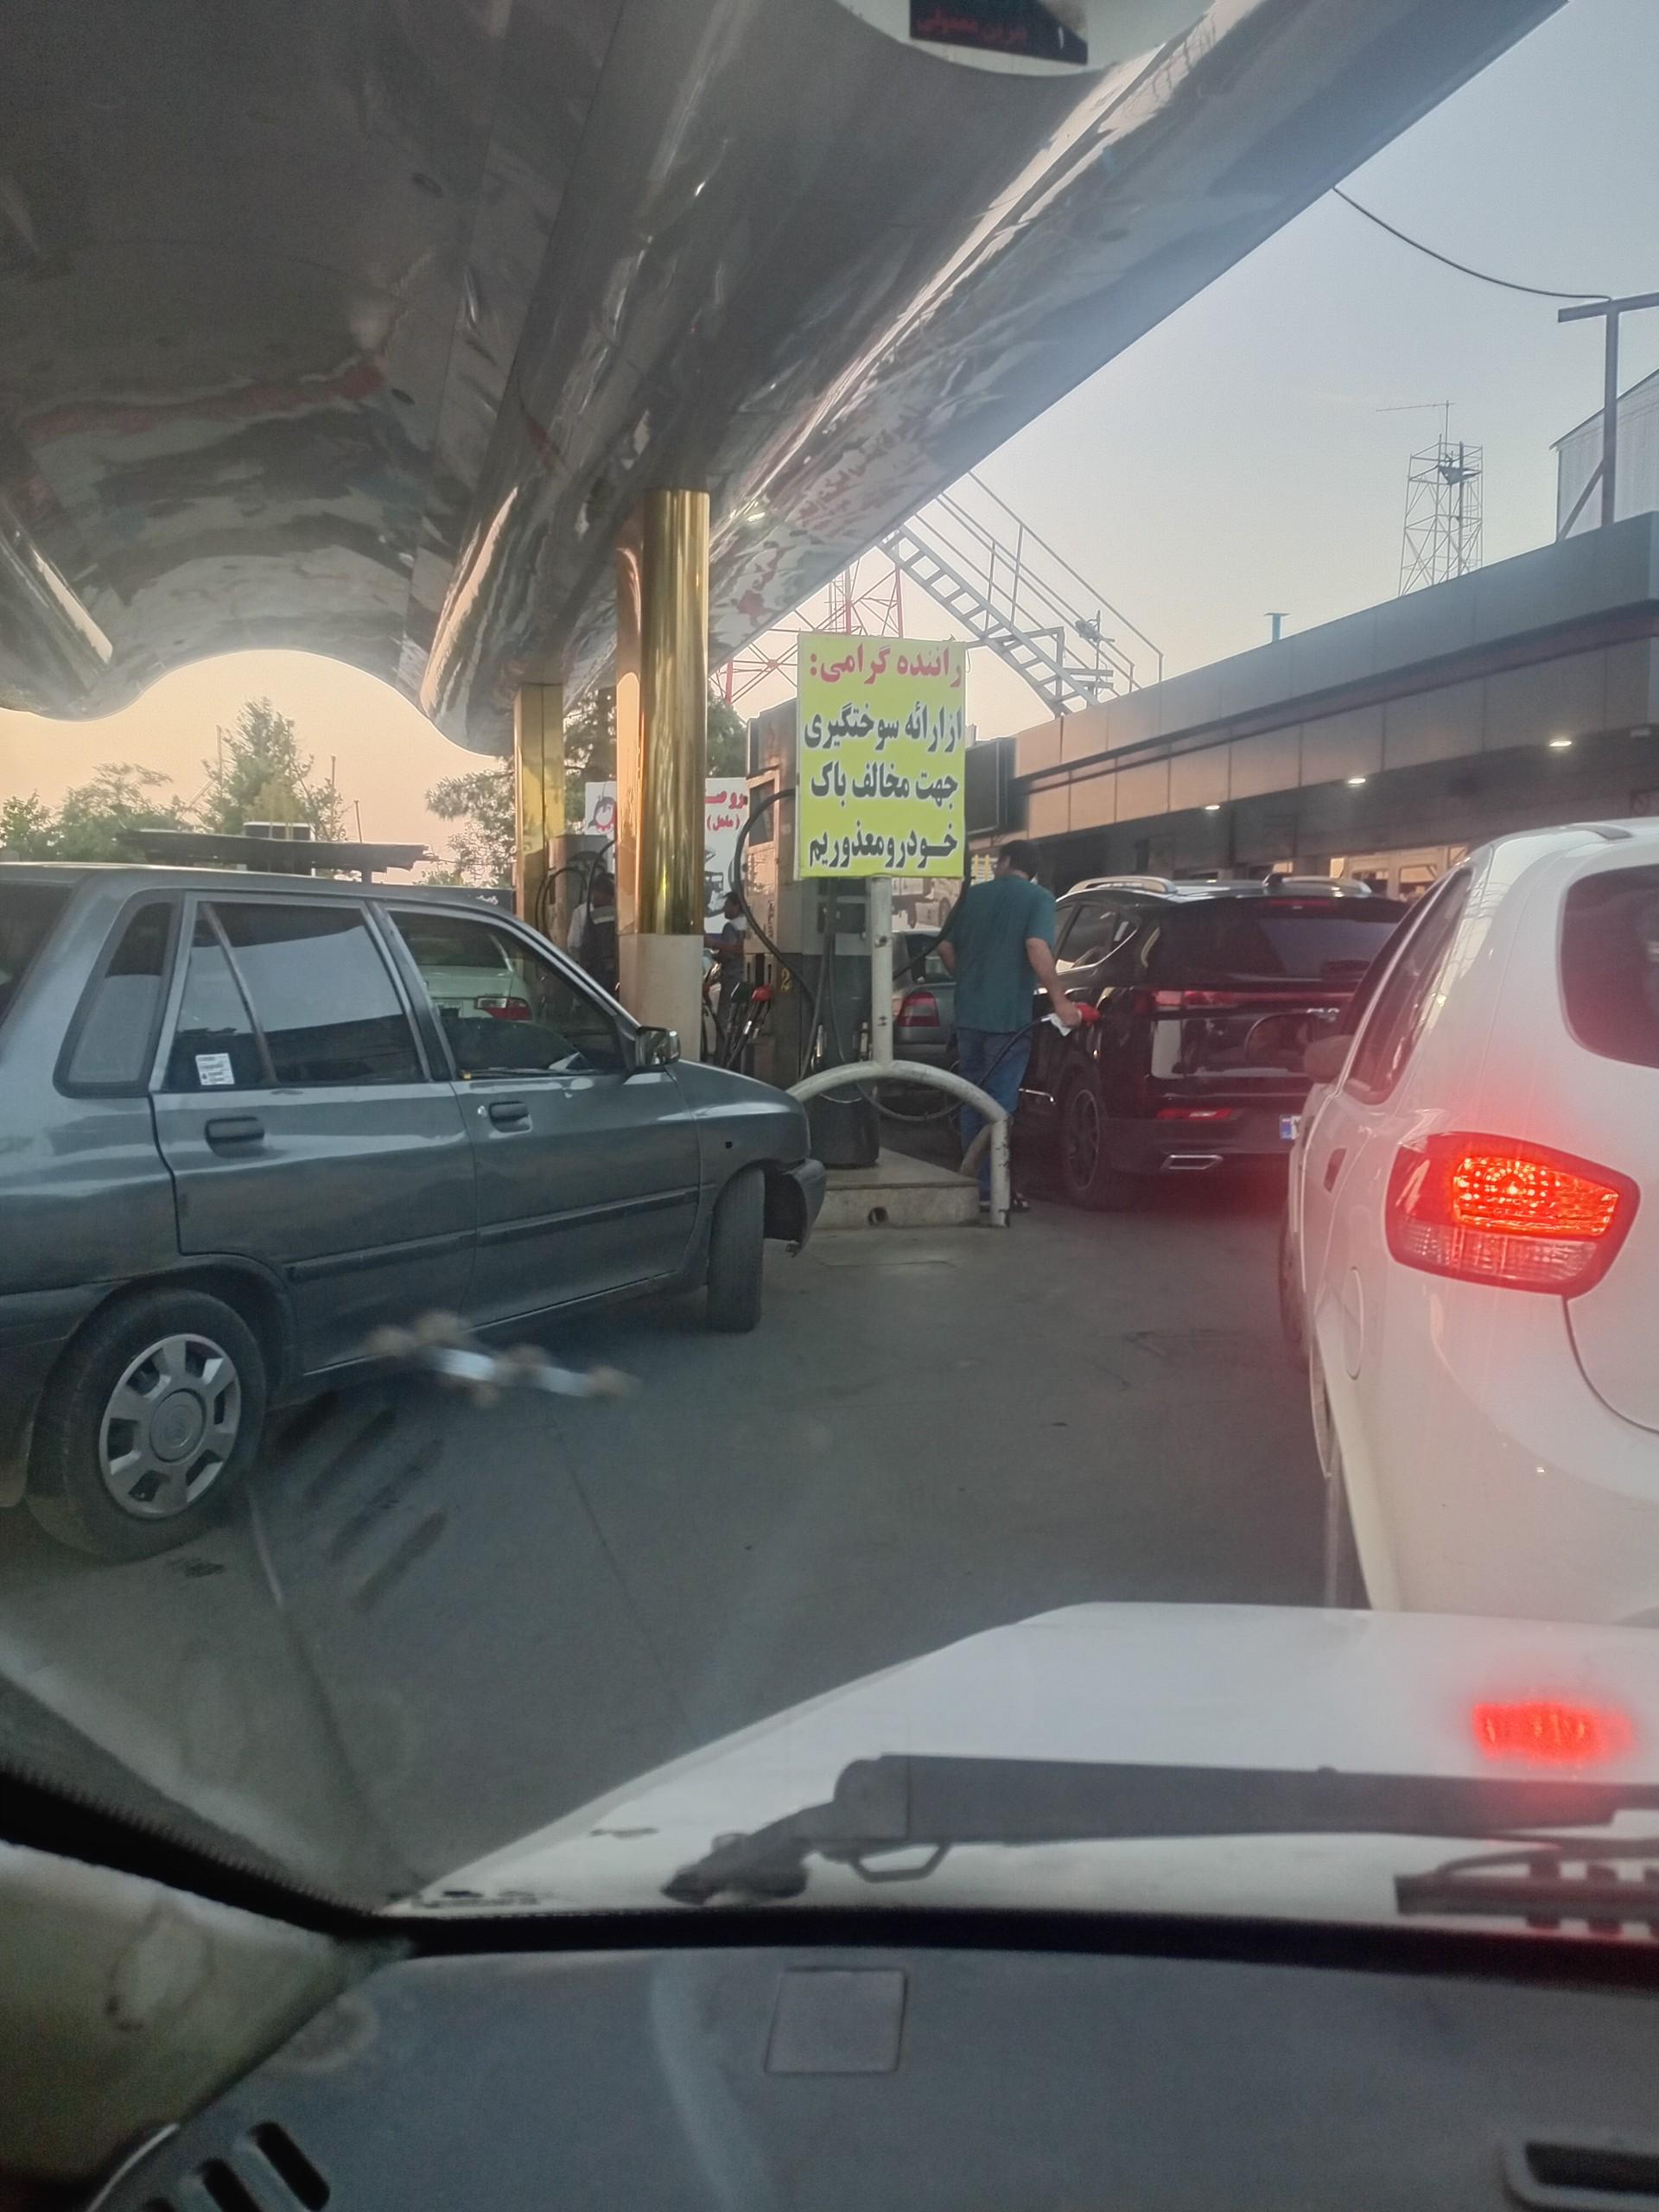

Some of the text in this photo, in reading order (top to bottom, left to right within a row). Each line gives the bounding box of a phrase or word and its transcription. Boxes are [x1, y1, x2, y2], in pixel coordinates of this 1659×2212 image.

[896, 646, 963, 688] راننده
[852, 762, 910, 799] مخالف
[915, 770, 958, 810] جهت
